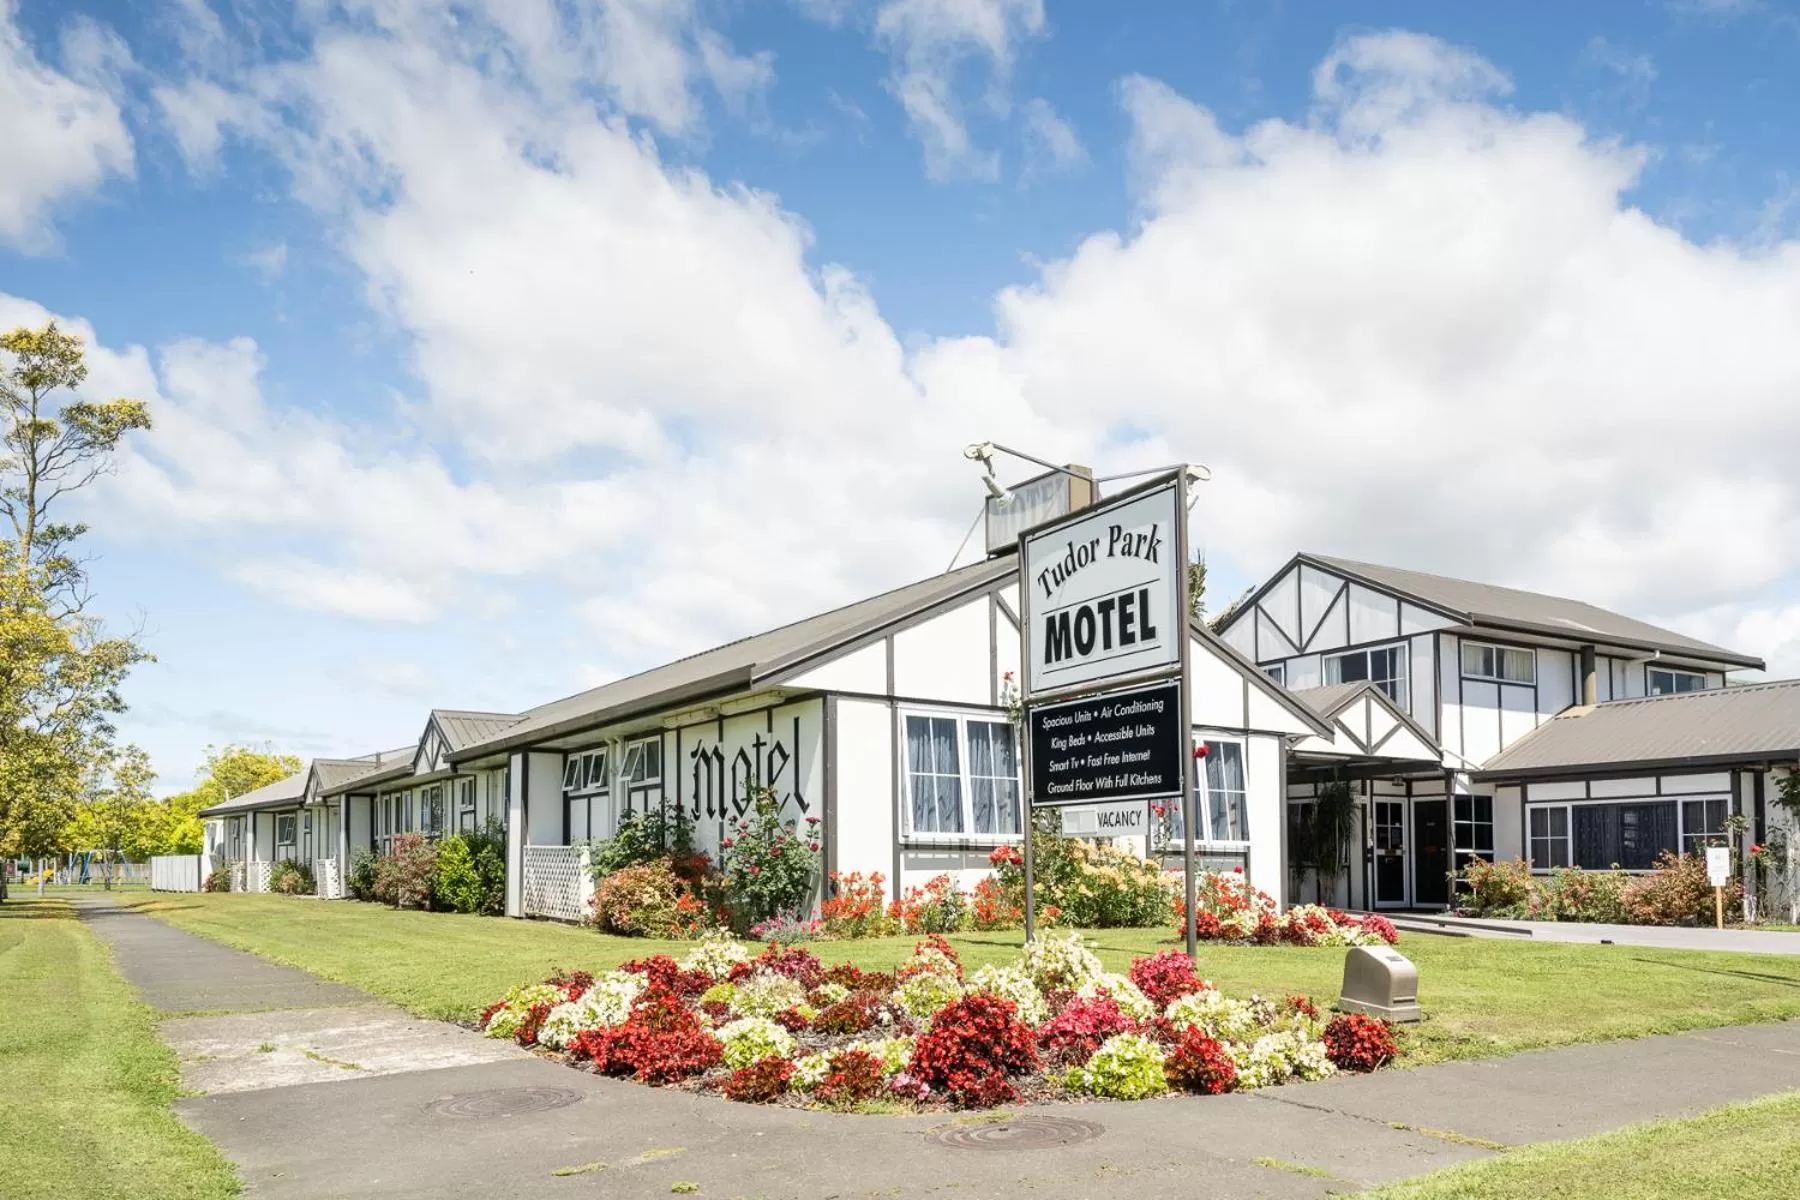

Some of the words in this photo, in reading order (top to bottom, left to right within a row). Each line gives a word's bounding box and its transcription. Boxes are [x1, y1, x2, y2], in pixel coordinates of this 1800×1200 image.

[1037, 537, 1100, 599] Tudor
[1106, 523, 1162, 565] Park
[1044, 588, 1157, 665] MOTEL
[1042, 716, 1073, 731] Spacious
[1074, 711, 1092, 724] Units
[1100, 707, 1112, 719] Air
[1114, 699, 1164, 717] Conditioning
[1051, 737, 1067, 750] King
[1068, 734, 1086, 747] Beds
[1093, 724, 1133, 744] Accessible
[1135, 724, 1155, 738] Units
[1049, 759, 1069, 773] Smart
[1087, 755, 1101, 767] Fast
[1103, 752, 1120, 765] Free
[1121, 749, 1150, 763] Internet
[1047, 779, 1074, 794] Ground
[1075, 777, 1093, 791] Floor
[1095, 774, 1113, 789] With
[1115, 773, 1128, 788] Full
[1130, 771, 1162, 786] Kitchens
[1097, 810, 1141, 828] VACANCY
